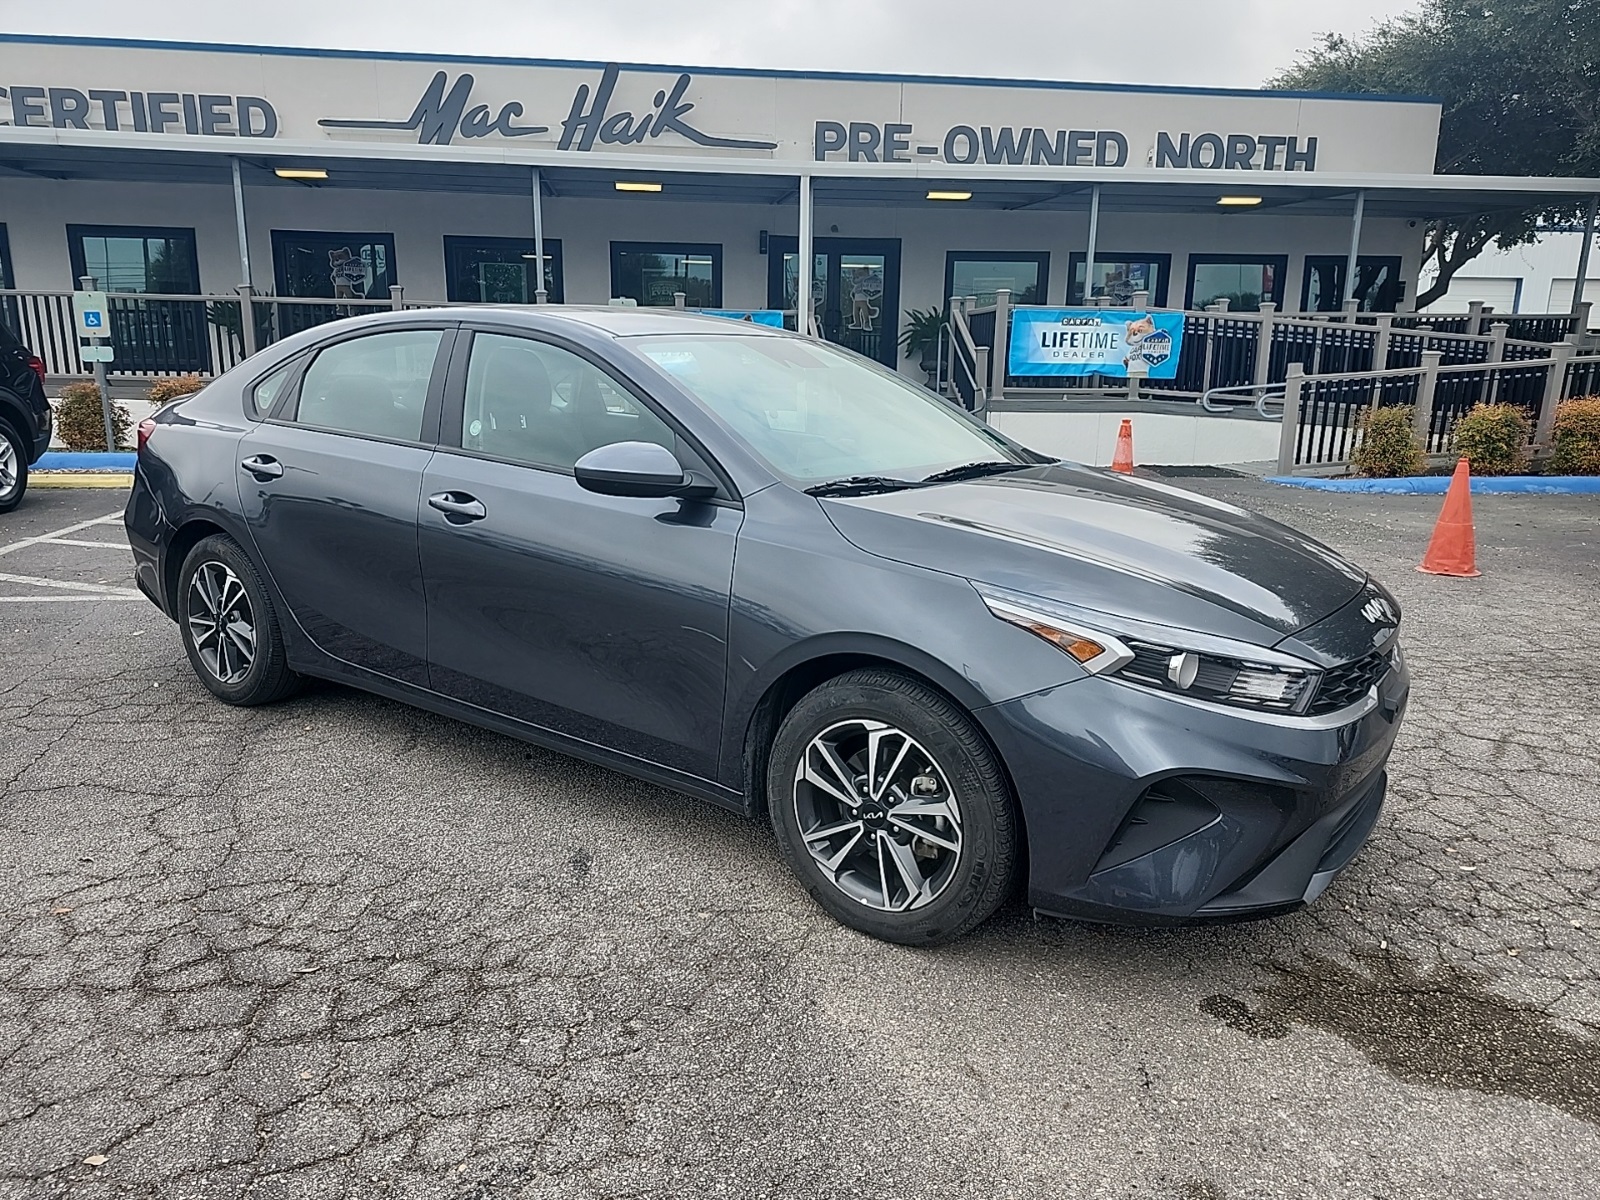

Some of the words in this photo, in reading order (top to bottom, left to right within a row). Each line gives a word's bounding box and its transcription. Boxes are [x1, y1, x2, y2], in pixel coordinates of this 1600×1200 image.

[0, 86, 278, 138] ERTIFIED
[318, 70, 549, 146] Mac
[557, 62, 777, 152] Haik
[814, 120, 1129, 168] PRE-OWNED
[1155, 131, 1319, 172] NORTH
[1041, 331, 1119, 349] LIFETIME
[1062, 317, 1102, 326] CARFAX
